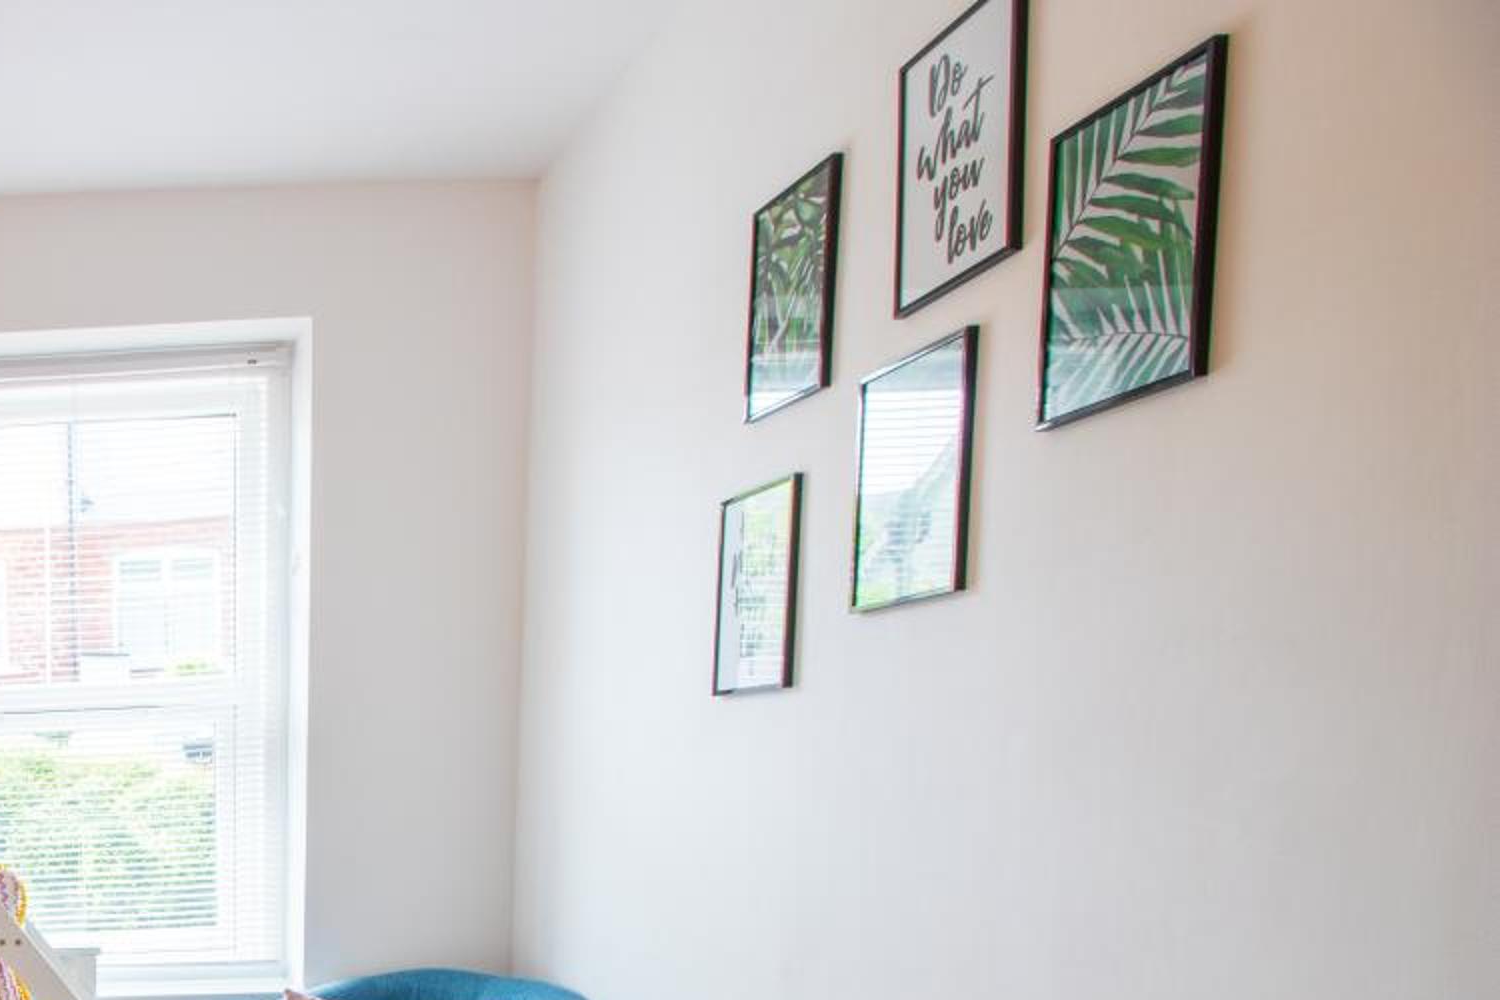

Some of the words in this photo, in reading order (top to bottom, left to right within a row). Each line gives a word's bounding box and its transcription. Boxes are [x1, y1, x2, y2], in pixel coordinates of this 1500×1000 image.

[929, 54, 967, 117] Do
[917, 75, 994, 181] what
[934, 157, 985, 242] you
[948, 199, 993, 264] love
